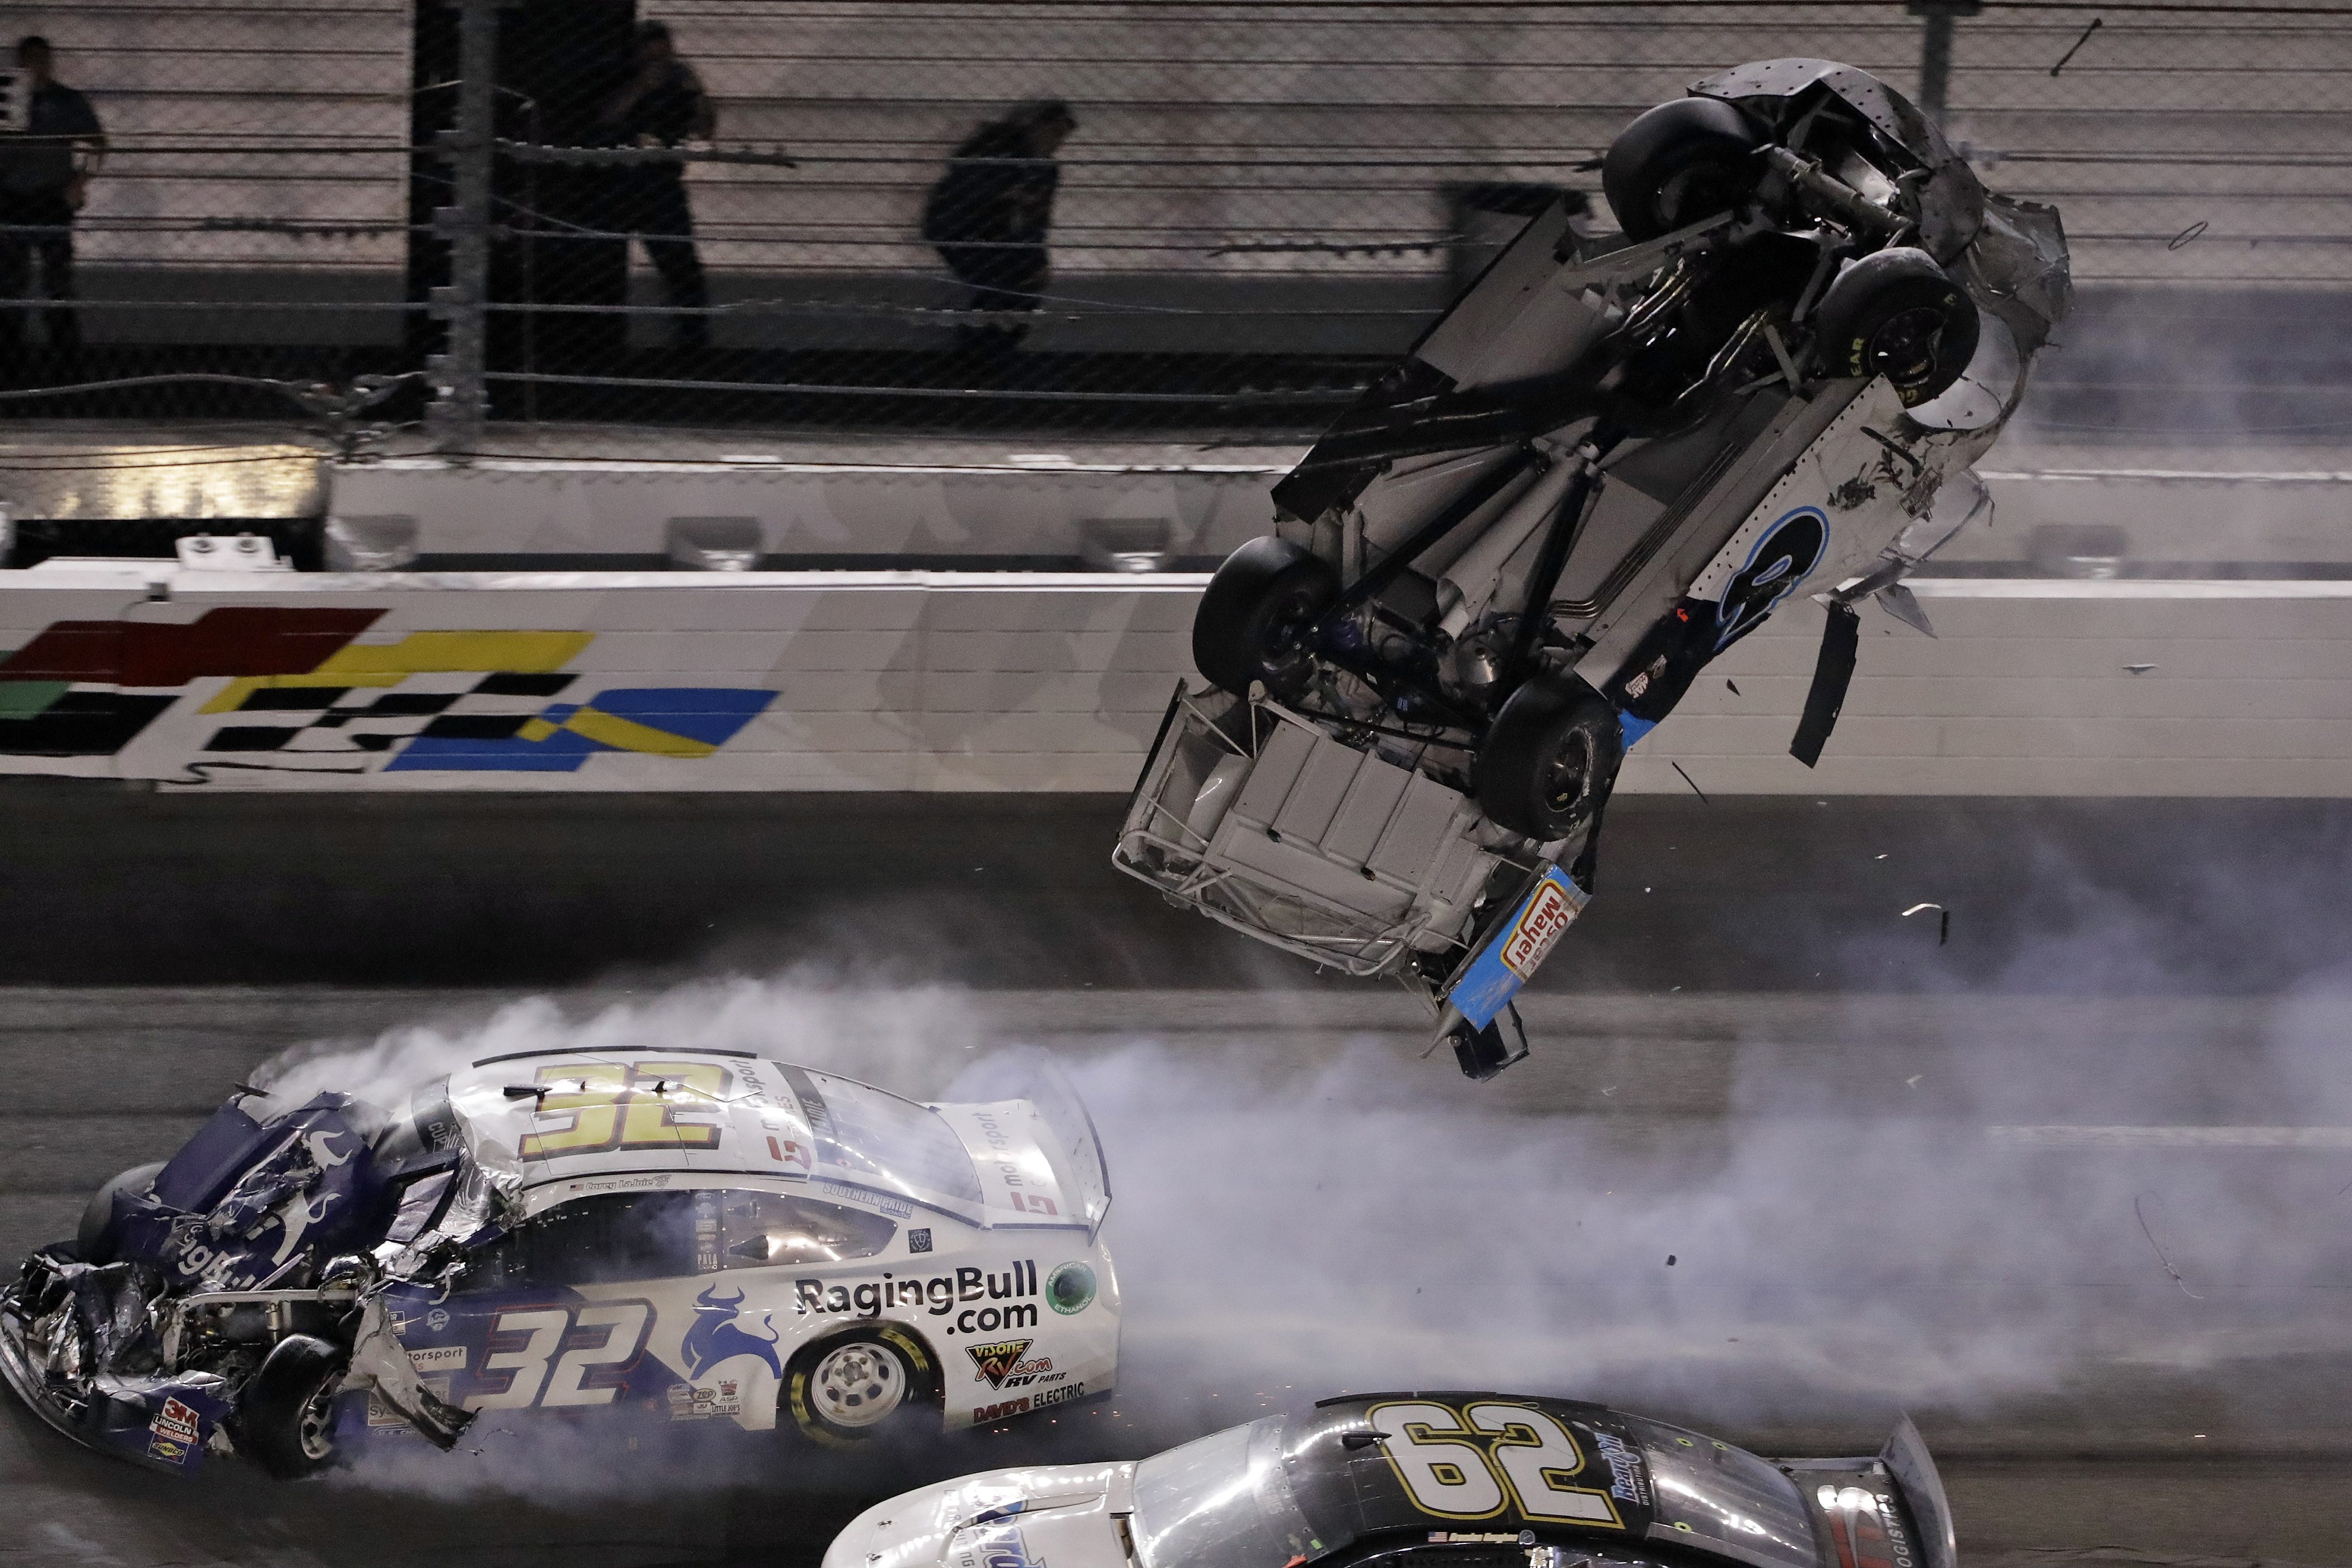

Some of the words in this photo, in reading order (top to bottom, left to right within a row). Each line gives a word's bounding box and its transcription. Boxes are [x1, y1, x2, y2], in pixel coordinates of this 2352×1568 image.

[1514, 895, 1561, 965] Mayer
[517, 1060, 734, 1163] 32
[618, 1179, 653, 1188] LaJoie
[823, 1183, 880, 1206] SOUTHERN
[880, 1196, 913, 1214] PRIDE
[795, 1259, 1038, 1319] RagingBull
[1054, 1296, 1093, 1313] ETHANOL
[946, 1301, 1038, 1334] .com
[464, 1297, 657, 1409] 32
[1005, 1374, 1038, 1388] RV
[1038, 1373, 1066, 1383] PARTS
[165, 1400, 198, 1429] 3M
[974, 1397, 1029, 1422] DAVID'S
[1033, 1382, 1084, 1407] ELECTRIC
[155, 1416, 192, 1435] LINCOLN
[160, 1427, 193, 1442] WELDERS
[154, 1443, 183, 1455] SUNOCO
[1365, 1400, 1626, 1529] 62
[1876, 1494, 1912, 1567] OGISTICS
